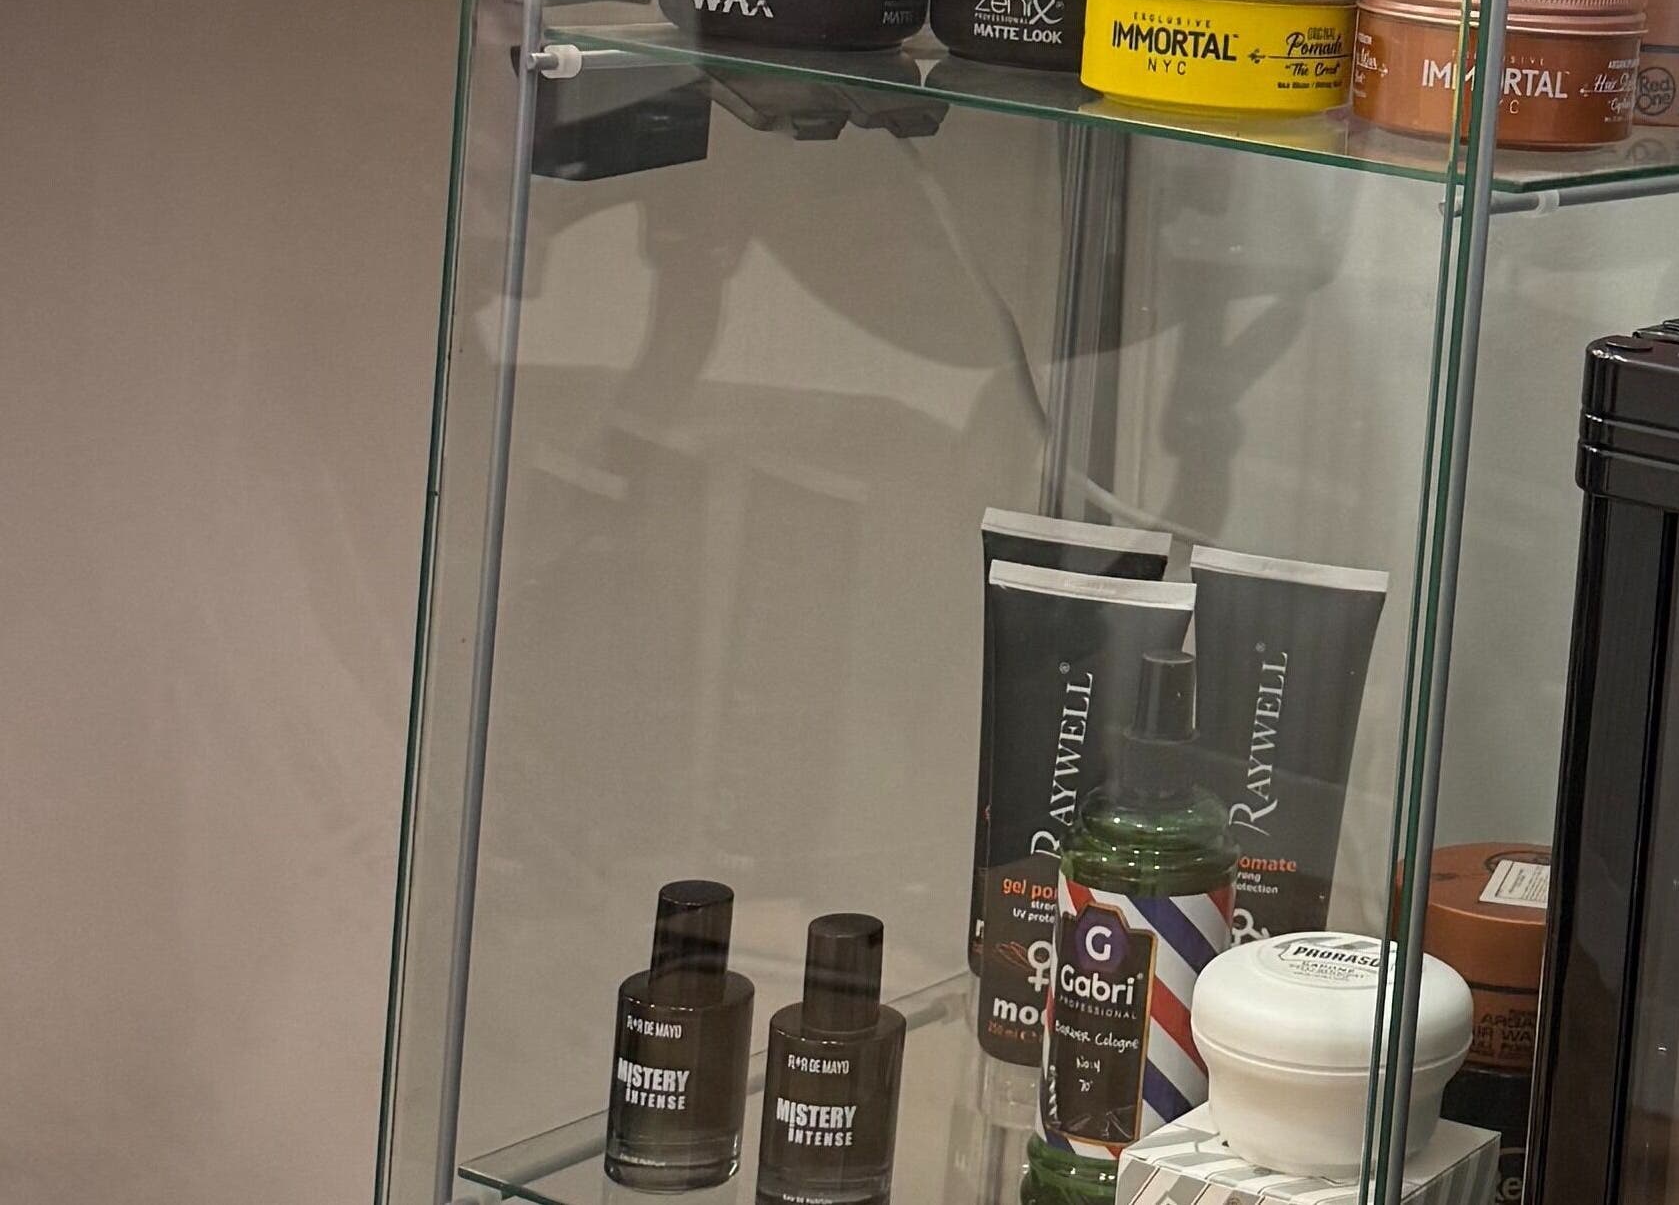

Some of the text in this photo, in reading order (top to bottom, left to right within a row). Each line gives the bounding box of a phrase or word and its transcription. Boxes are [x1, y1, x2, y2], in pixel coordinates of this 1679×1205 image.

[1133, 11, 1212, 29] EXCLUSIVE
[974, 23, 1062, 44] MATTE LOOK
[1112, 20, 1237, 61] IMMORTAL
[1147, 58, 1187, 76] NYC
[1228, 651, 1288, 836] RAYWELL
[1239, 856, 1297, 872] omate
[1003, 877, 1026, 895] gel
[1013, 908, 1025, 920] UV
[1085, 925, 1113, 961] G
[1060, 964, 1135, 1005] Gabri
[1058, 995, 1138, 1021] PROFESSIONAL
[655, 1022, 682, 1040] MAYO
[1094, 1032, 1140, 1053] Cologne
[617, 1057, 690, 1094] MISTERY
[822, 1059, 850, 1075] MAYO
[625, 1088, 686, 1111] INTENSE
[776, 1097, 857, 1129] MISTERY
[788, 1125, 853, 1147] INTENSE
